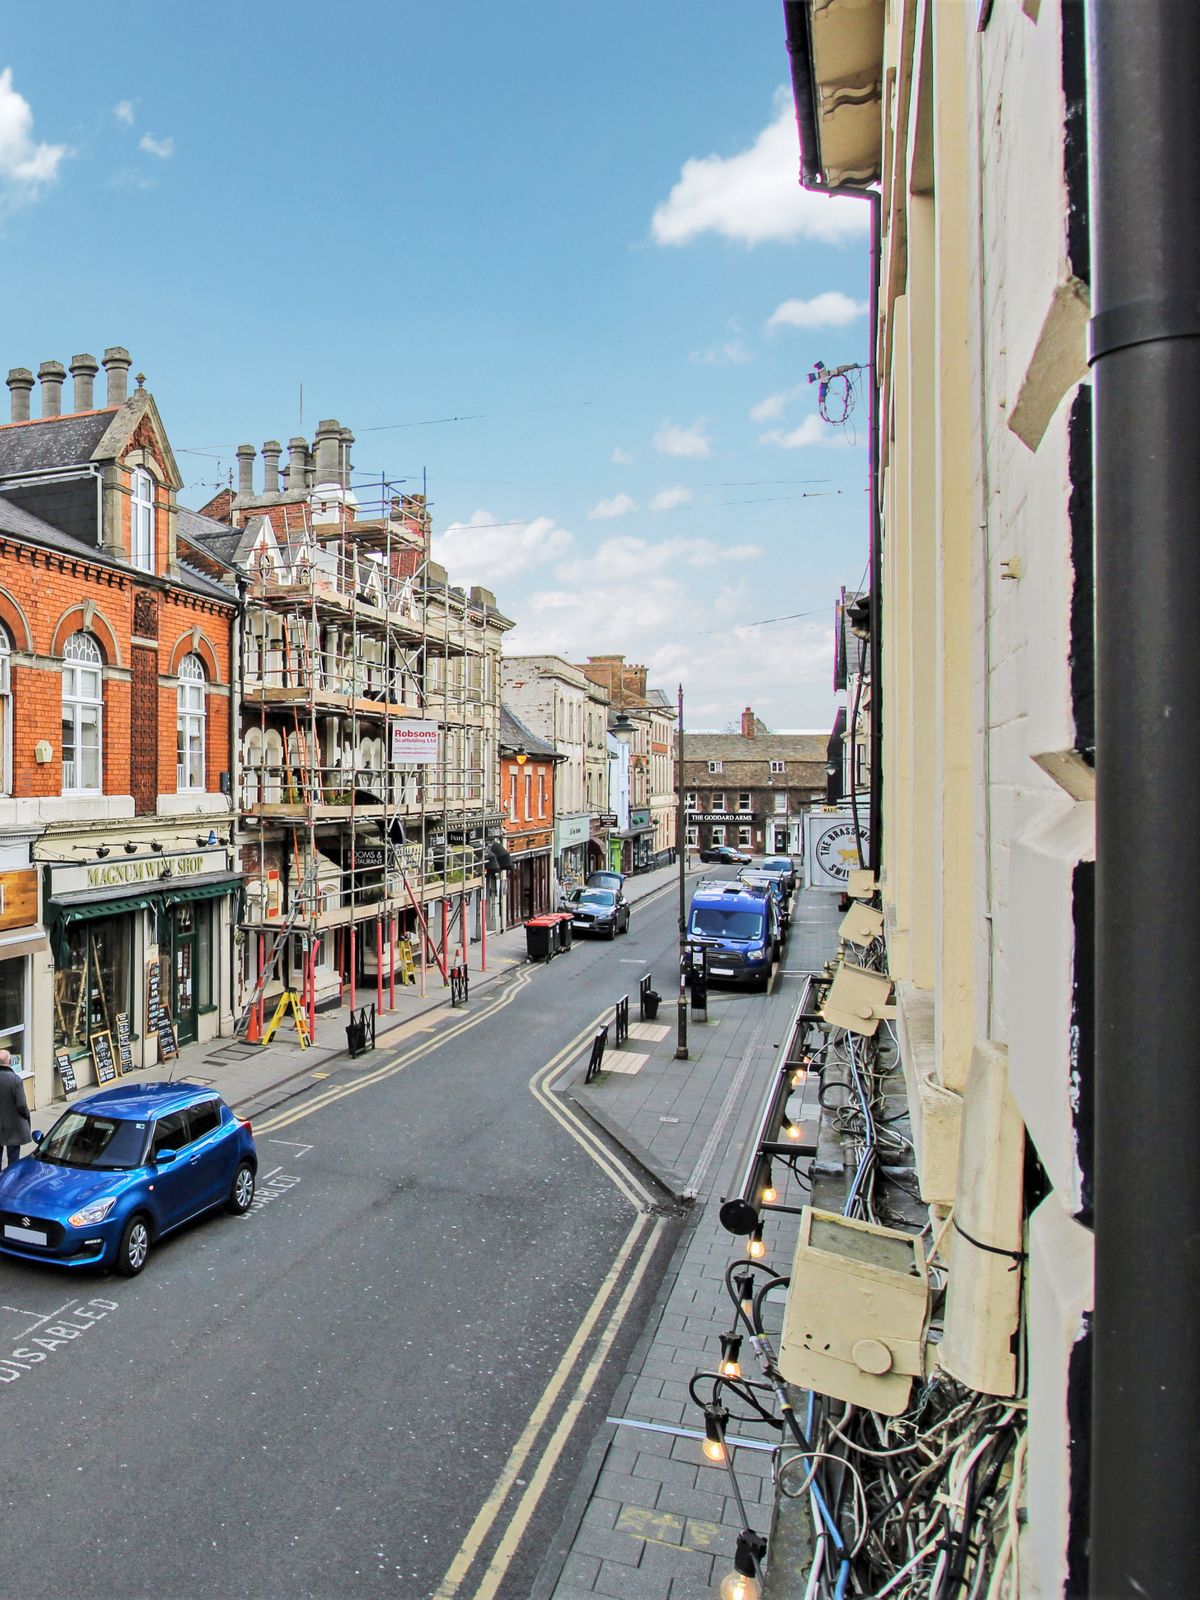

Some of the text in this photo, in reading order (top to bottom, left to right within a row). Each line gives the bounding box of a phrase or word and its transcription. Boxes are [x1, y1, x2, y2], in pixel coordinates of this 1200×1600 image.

[395, 729, 437, 738] Robsons
[821, 840, 831, 856] THE
[828, 827, 856, 841] BRASS
[87, 862, 145, 887] MAGNUM
[177, 856, 204, 875] SHOP
[829, 864, 849, 878] SWI
